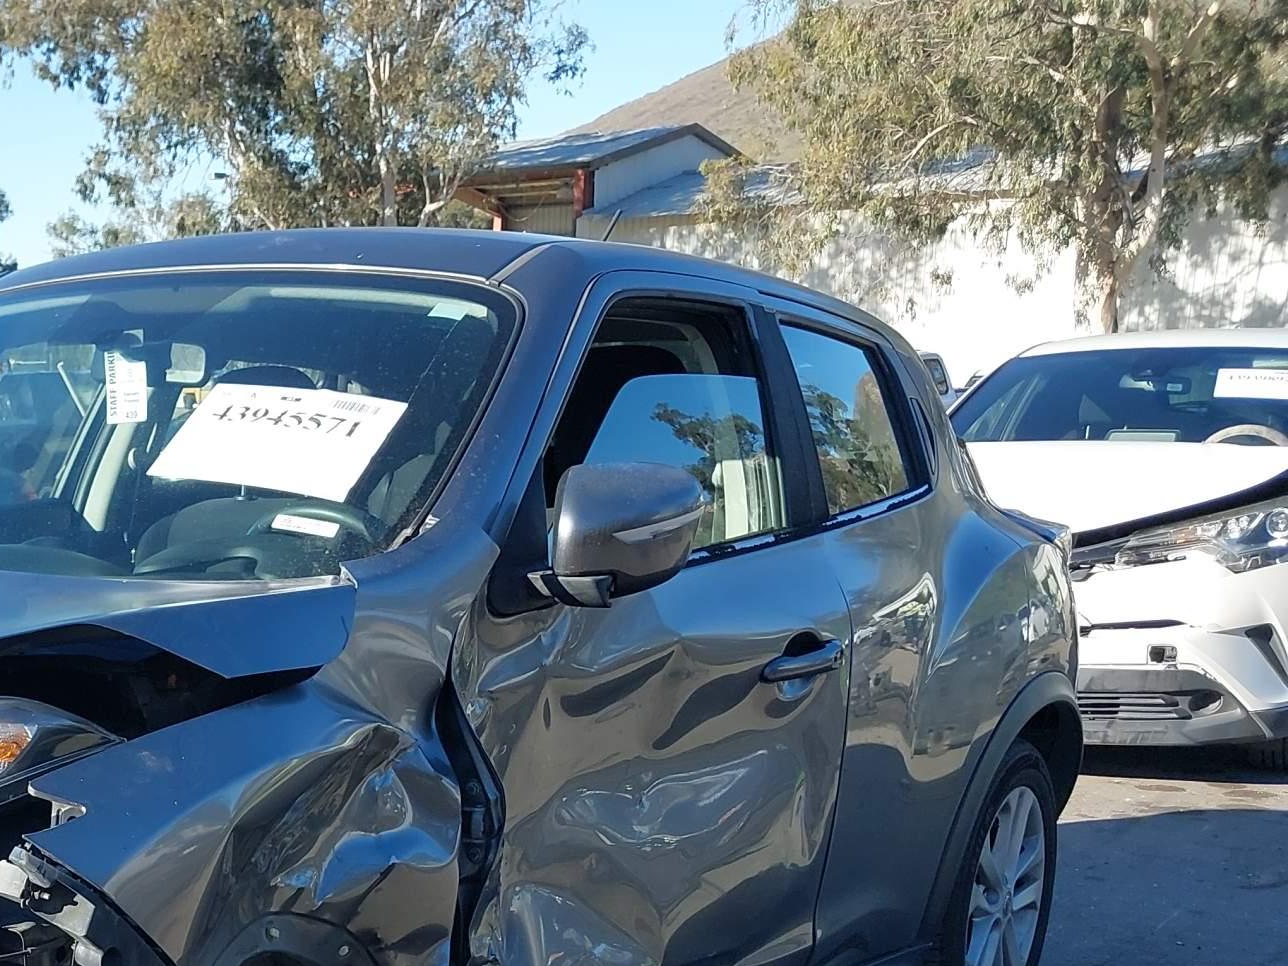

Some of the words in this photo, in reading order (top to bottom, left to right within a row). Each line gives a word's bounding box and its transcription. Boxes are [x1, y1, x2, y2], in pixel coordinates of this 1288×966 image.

[107, 351, 117, 385] PARKI
[109, 389, 118, 417] STAFF
[212, 404, 362, 438] 43945571
